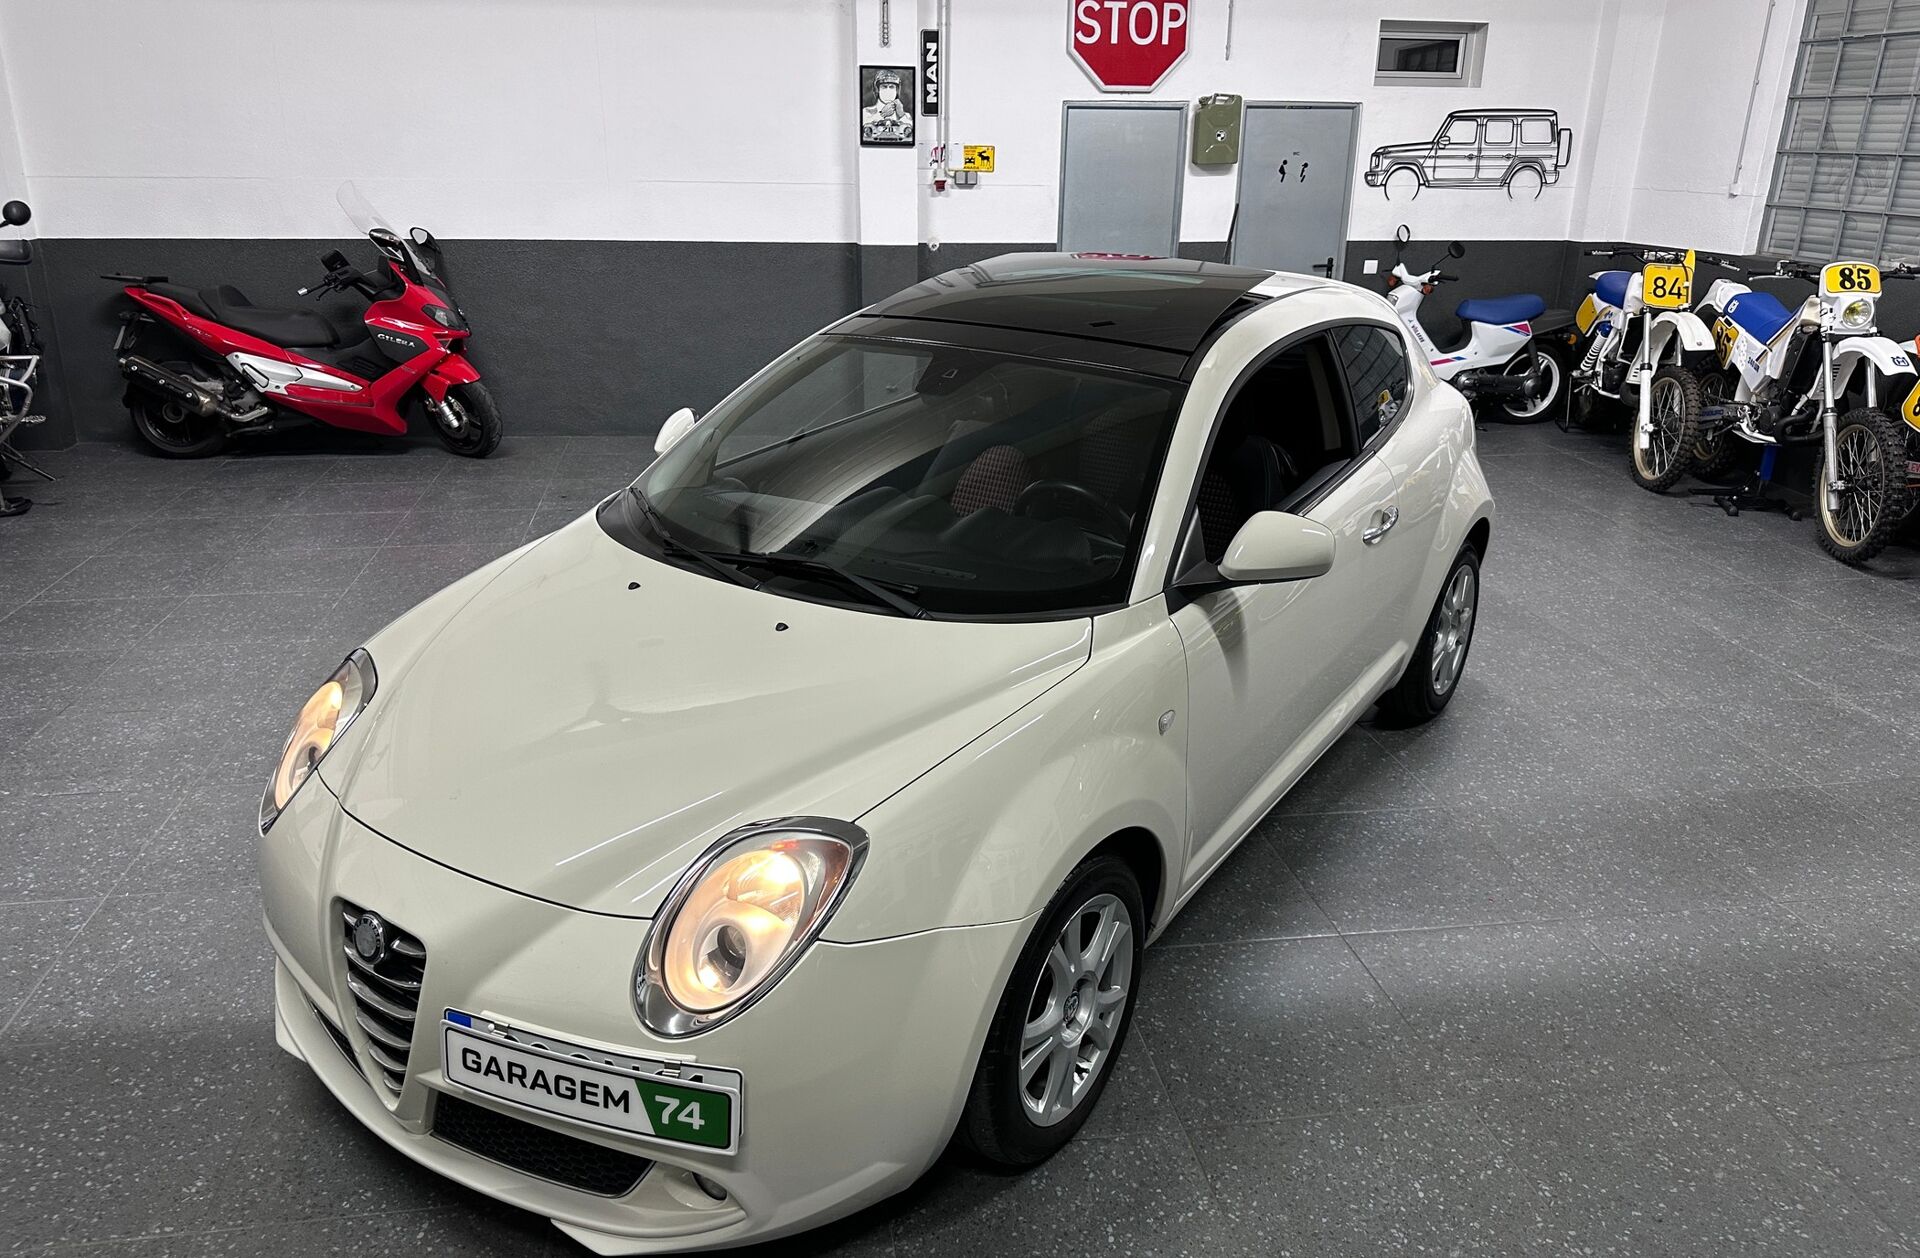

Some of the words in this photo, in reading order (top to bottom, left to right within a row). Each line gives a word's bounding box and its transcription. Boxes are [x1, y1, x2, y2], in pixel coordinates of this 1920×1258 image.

[1075, 0, 1186, 45] STOP
[926, 42, 938, 103] MAN
[1652, 276, 1682, 300] 84
[1839, 267, 1872, 290] 85
[377, 333, 416, 348] GILERA
[461, 1047, 630, 1114] GARAGEM
[655, 1095, 705, 1131] 74
